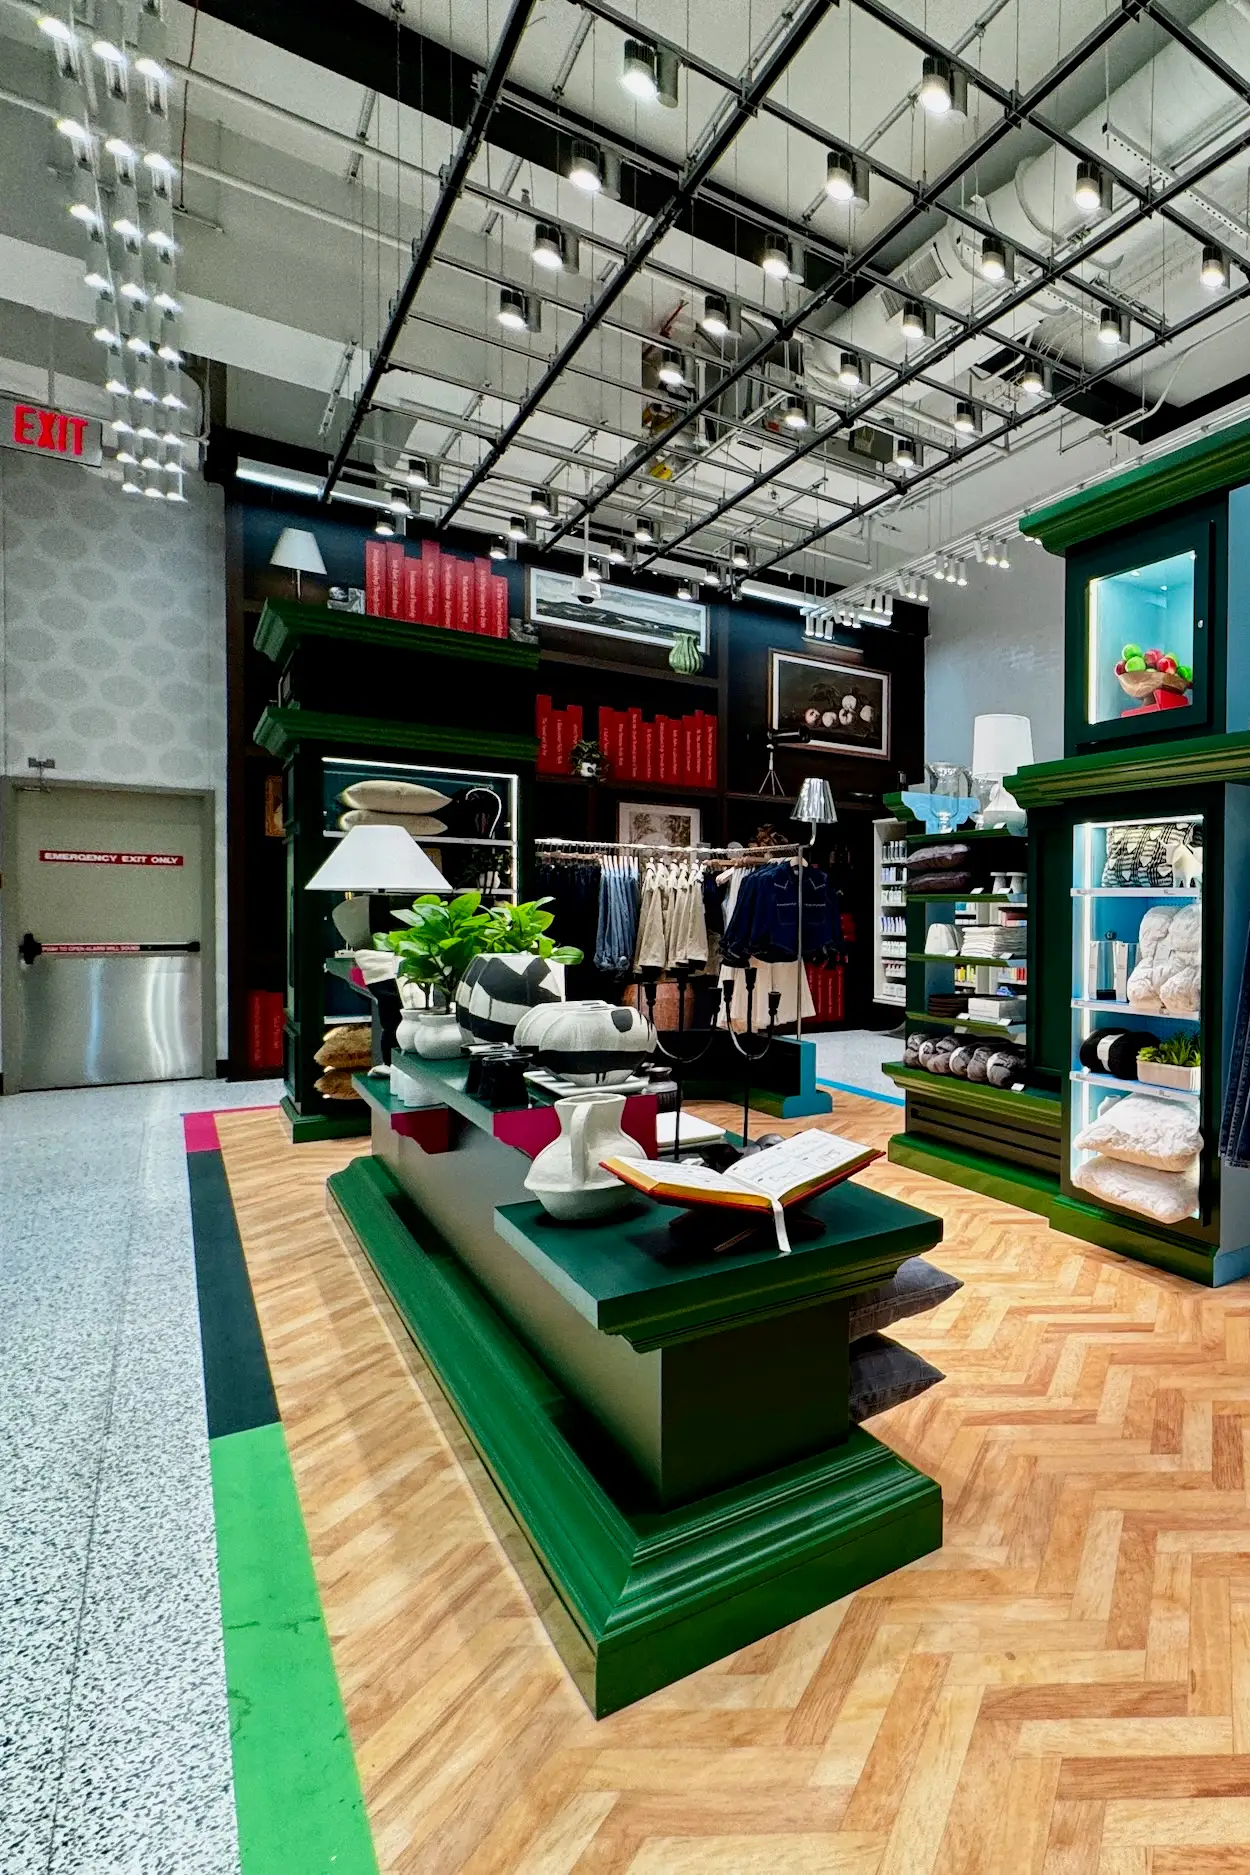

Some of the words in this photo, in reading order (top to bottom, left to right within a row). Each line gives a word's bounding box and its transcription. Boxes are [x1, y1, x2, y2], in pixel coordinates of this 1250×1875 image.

[13, 404, 88, 456] EXIT
[44, 852, 117, 863] EMERGENCY
[121, 854, 148, 864] EXIT
[151, 857, 179, 865] ONLY
